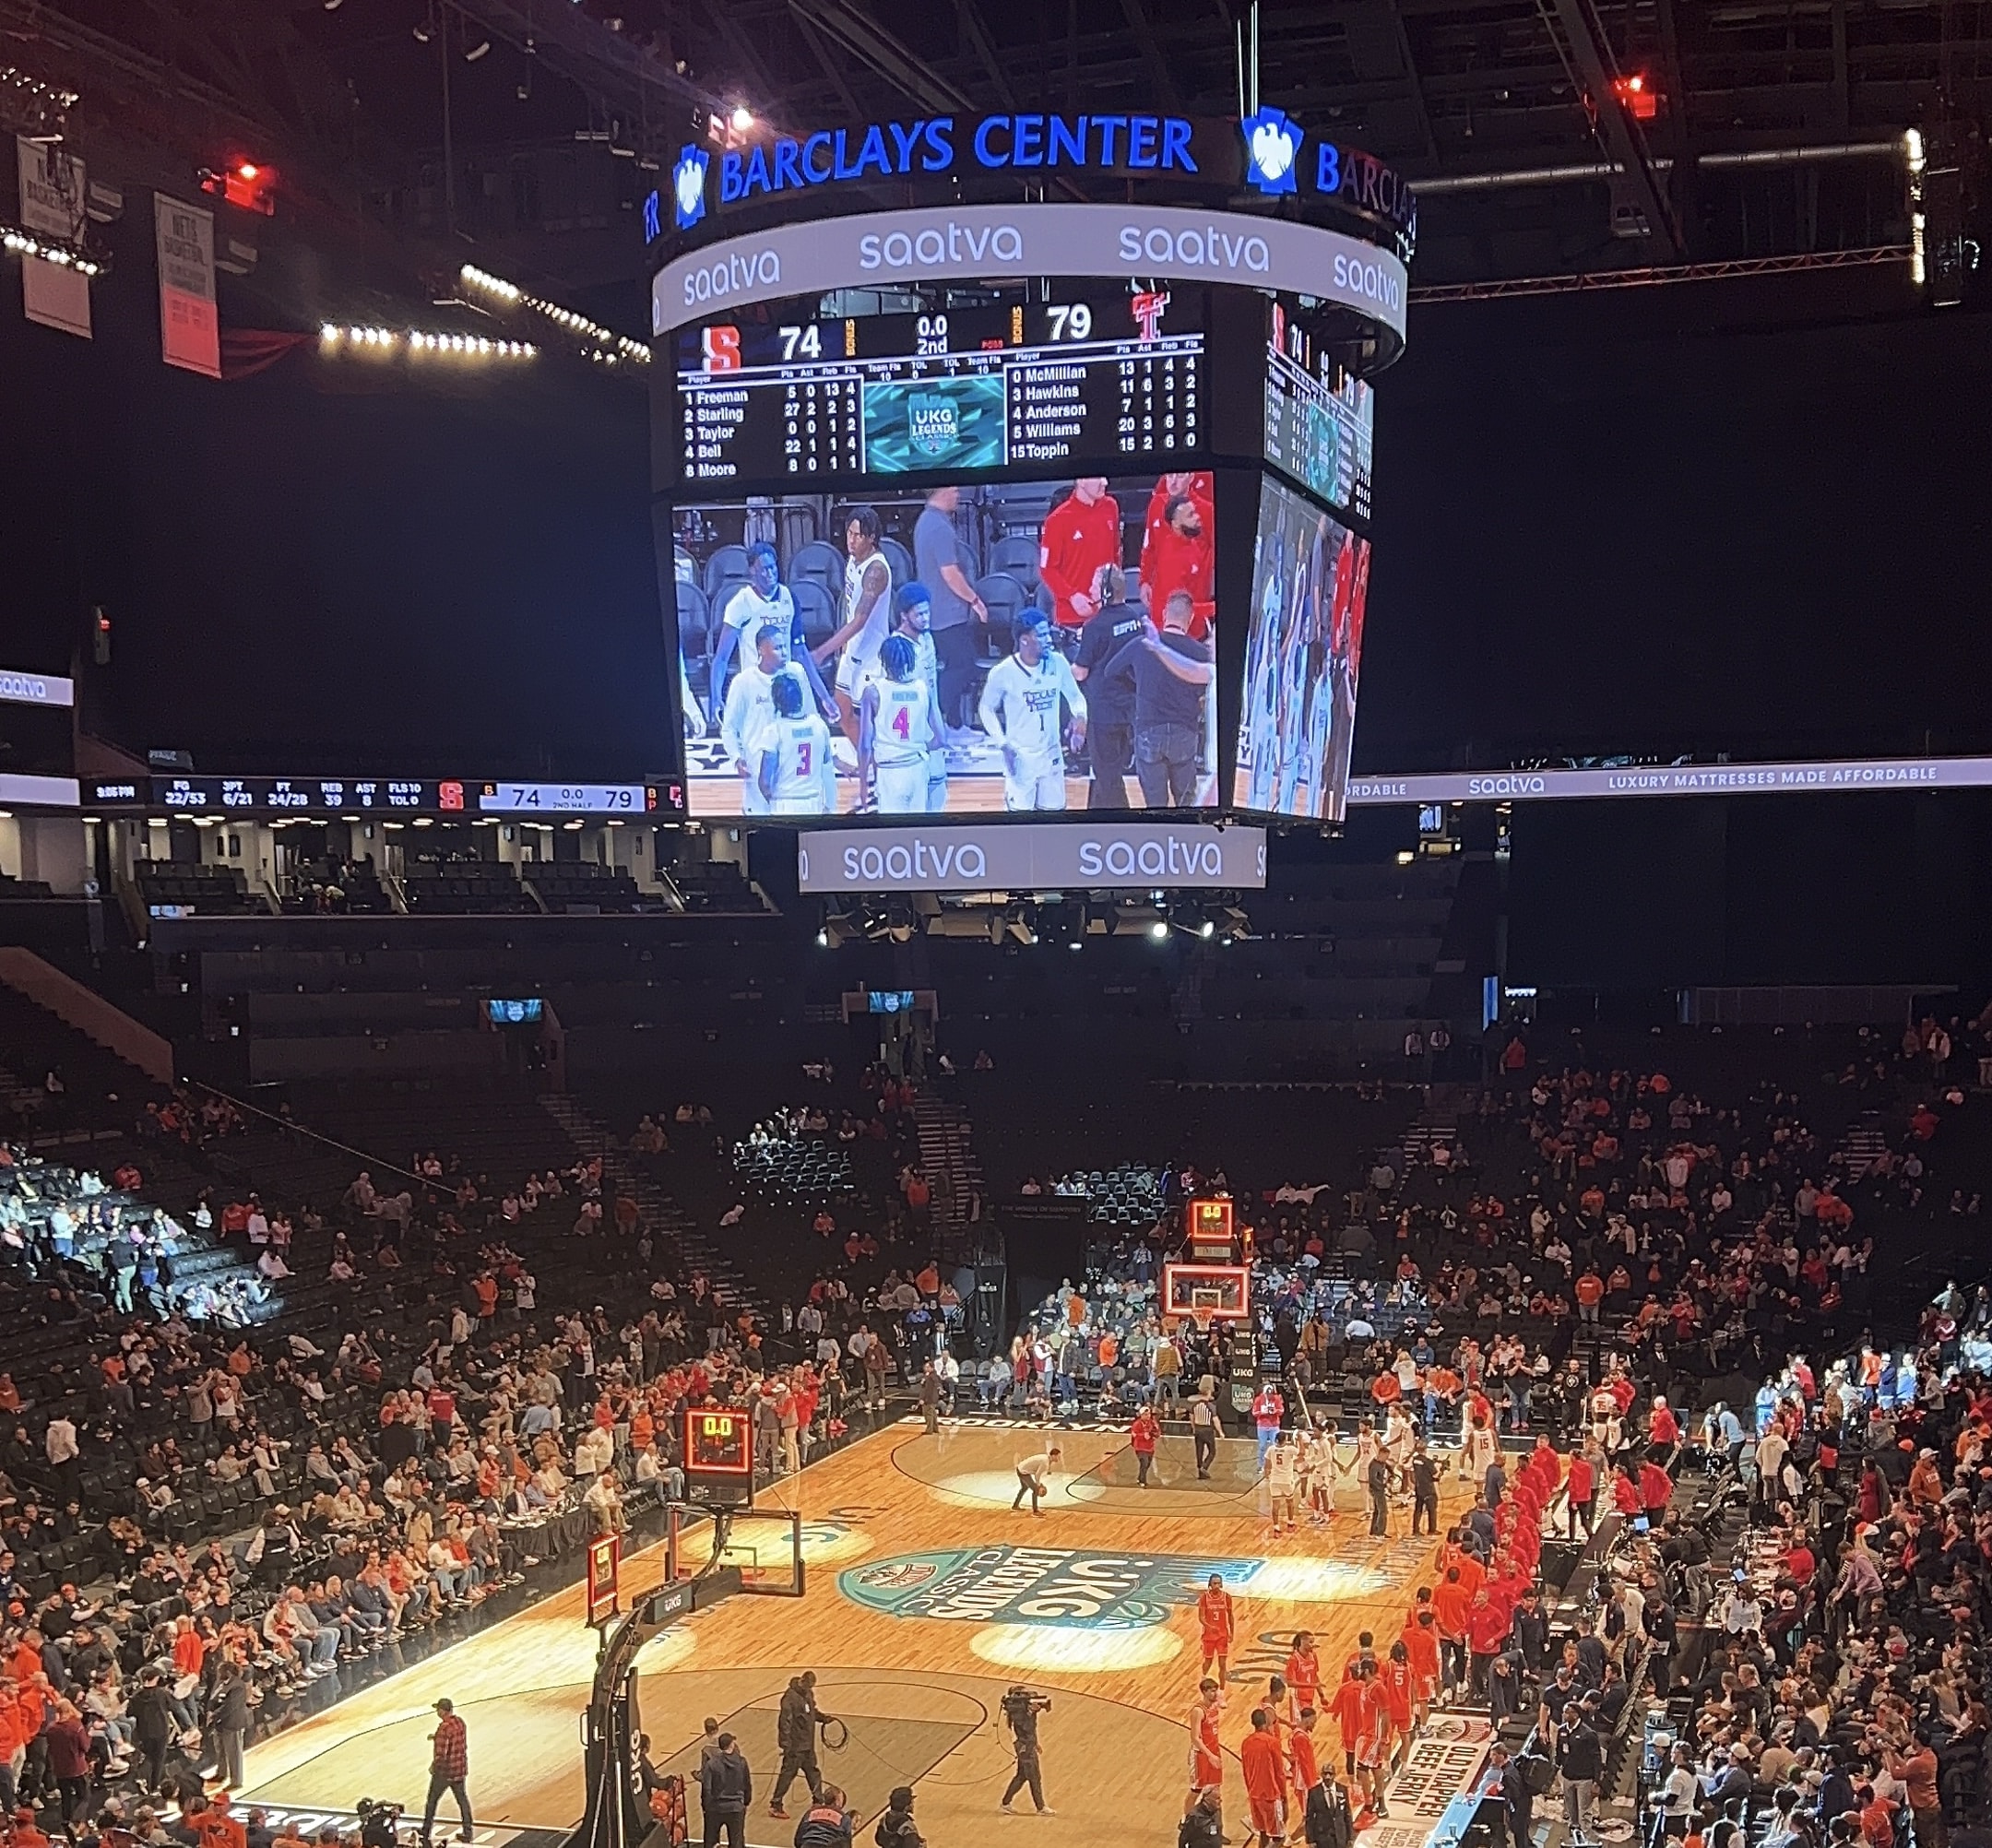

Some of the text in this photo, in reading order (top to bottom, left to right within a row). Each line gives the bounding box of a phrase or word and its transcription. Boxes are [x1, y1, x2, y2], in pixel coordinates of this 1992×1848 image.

[721, 113, 1198, 204] BARCLAYS CENTER
[859, 221, 1022, 269] saatva
[1119, 225, 1270, 272] saatva
[683, 249, 781, 306] saatva
[1333, 253, 1399, 313] saatva
[918, 314, 948, 337] 0.0
[1046, 303, 1092, 340] 79
[779, 325, 821, 360] 74
[918, 336, 948, 356] 2nd
[911, 361, 928, 370] TOL
[944, 358, 960, 367] TOL
[968, 357, 988, 366] Team
[1015, 352, 1039, 362] Player
[869, 363, 887, 373] Team
[880, 372, 892, 382] 10
[912, 371, 919, 380] 0
[949, 368, 955, 377] 1
[978, 365, 989, 375] 10
[1013, 356, 1195, 383] 0 McMillian 13 1 4 4
[688, 376, 711, 385] Player
[1013, 374, 1195, 401] 3 Hawkins 11 6 3 2
[685, 382, 856, 405] 1 Freeman 5 0 13 4
[684, 398, 856, 423] 2 Starling 27 2 2 3
[916, 409, 953, 424] UKG
[1013, 394, 1195, 420] 4 Anderson 7 1 1 2
[685, 417, 856, 442] 3 Taylor 0 0 1 2
[912, 422, 957, 436] LEGENDS
[1026, 412, 1195, 438] Williams 20 3 6 3
[685, 435, 856, 458] 4 Bell 22 1 1 4
[1011, 432, 1196, 459] 15 Toppin 15 2 6 0
[685, 455, 856, 478] 8 Moore 8 0 1 1
[891, 705, 910, 742] 4
[1038, 714, 1046, 732] 1
[796, 742, 812, 776] 3
[172, 780, 190, 790] FG
[222, 781, 243, 791] 3PT
[277, 782, 290, 791] FT
[321, 783, 343, 792] REB
[355, 784, 376, 793] AST
[388, 783, 421, 793] FLS 10
[1468, 766, 1937, 795] saatva LUXURY MATTRESSES MADE AFFORDABLE
[222, 793, 253, 807] 6/21
[325, 794, 343, 806] 39
[484, 785, 494, 796] B
[512, 788, 541, 807] 74
[561, 788, 584, 800] 0.0
[605, 790, 633, 809] 79
[647, 788, 657, 799] B
[362, 795, 373, 807] 8
[388, 795, 409, 806] TOL
[553, 801, 593, 810] 2ND HALF
[843, 839, 987, 880] saatva
[1078, 835, 1223, 877] saatva
[1232, 1368, 1254, 1377] UKG
[706, 1417, 731, 1436] 0.0
[898, 1416, 1132, 1433] BROOKLYN
[1479, 1438, 1489, 1451] 15
[1275, 1453, 1283, 1465] 5
[901, 1550, 1002, 1610] CLASSIC
[927, 1547, 1077, 1620] LEGENDS
[1018, 1559, 1154, 1617] UKG
[1213, 1611, 1219, 1621] 3
[1394, 1672, 1404, 1687] 5
[631, 1729, 643, 1795] UKG
[1444, 1746, 1479, 1767] OLD
[1389, 1743, 1449, 1806] BEEF JERKY
[1414, 1768, 1468, 1818] TRAPPER
